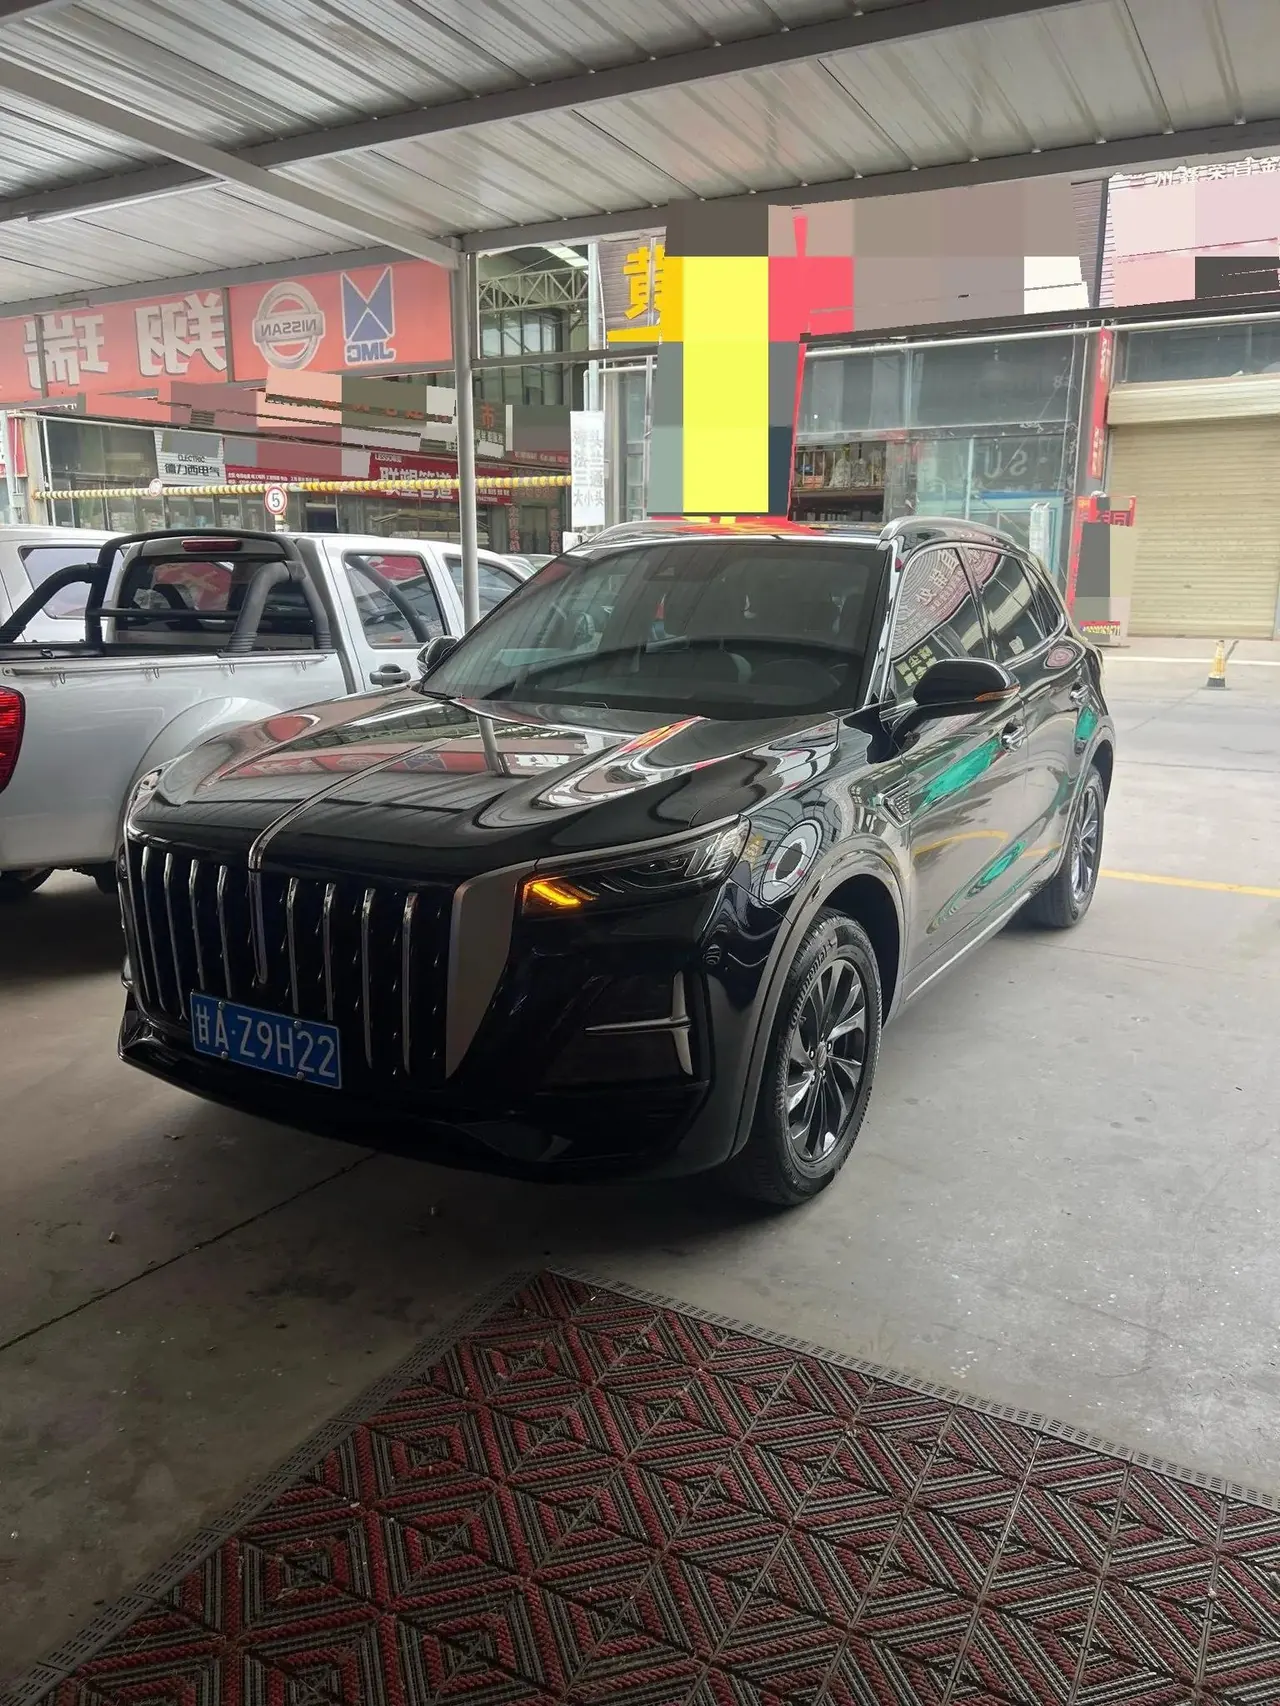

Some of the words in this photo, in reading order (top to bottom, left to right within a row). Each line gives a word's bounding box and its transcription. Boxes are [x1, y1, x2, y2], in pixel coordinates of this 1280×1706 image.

[164, 463, 221, 477] 德力西电气
[271, 492, 281, 508] 5
